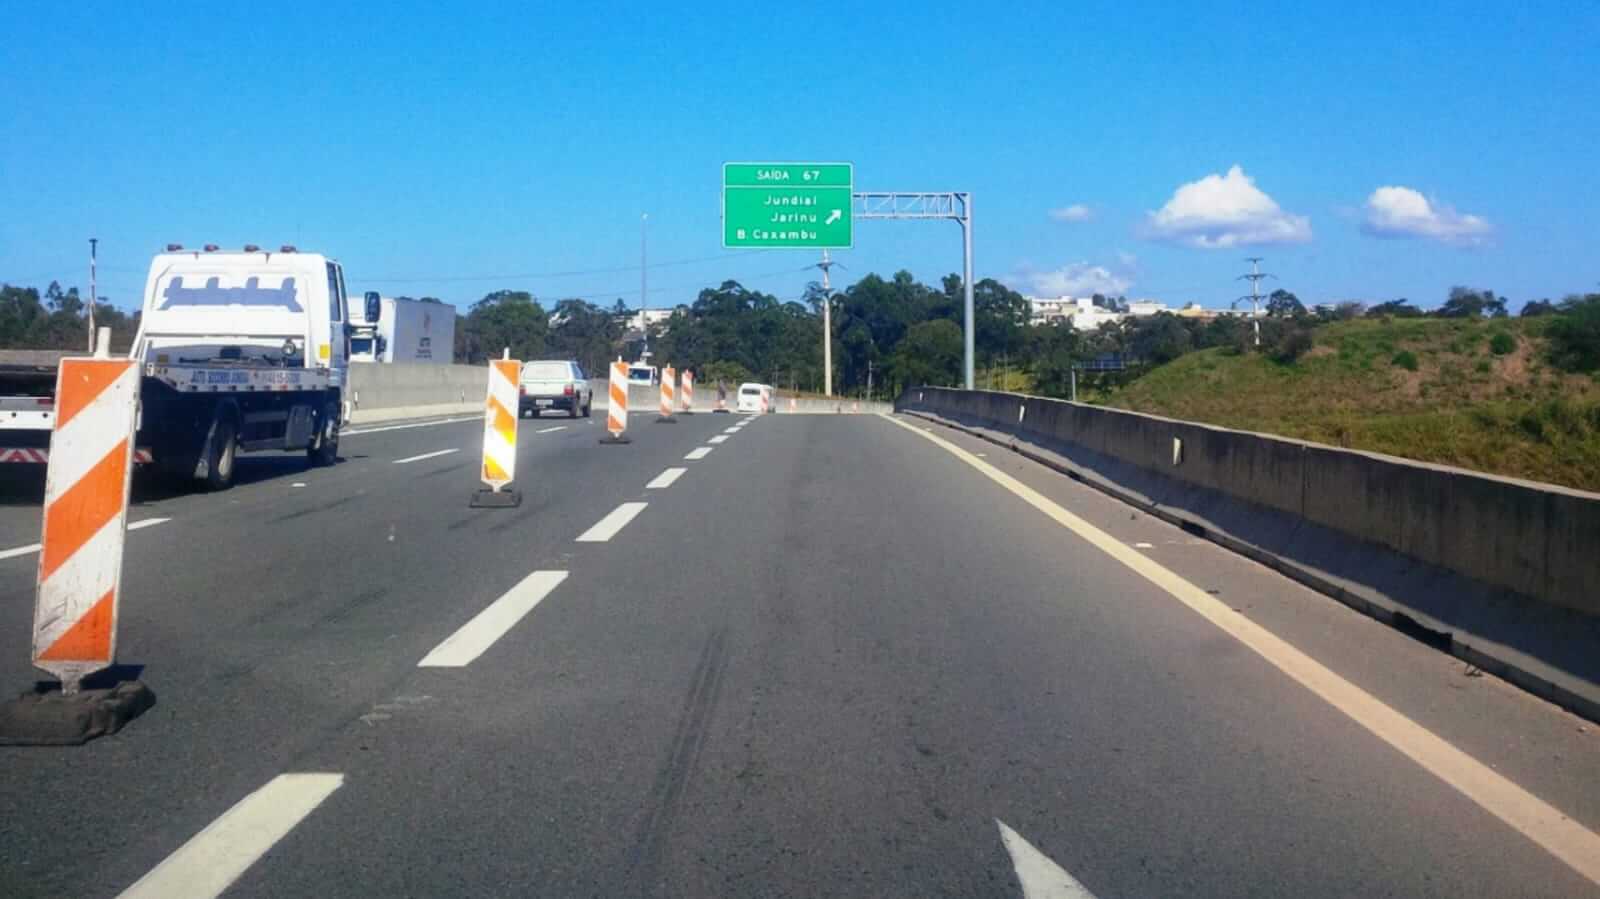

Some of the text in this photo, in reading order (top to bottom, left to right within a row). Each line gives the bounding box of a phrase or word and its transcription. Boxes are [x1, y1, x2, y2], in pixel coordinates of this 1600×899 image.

[803, 171, 820, 180] 67
[771, 212, 817, 223] Jarinu
[753, 229, 817, 239] Caxambu
